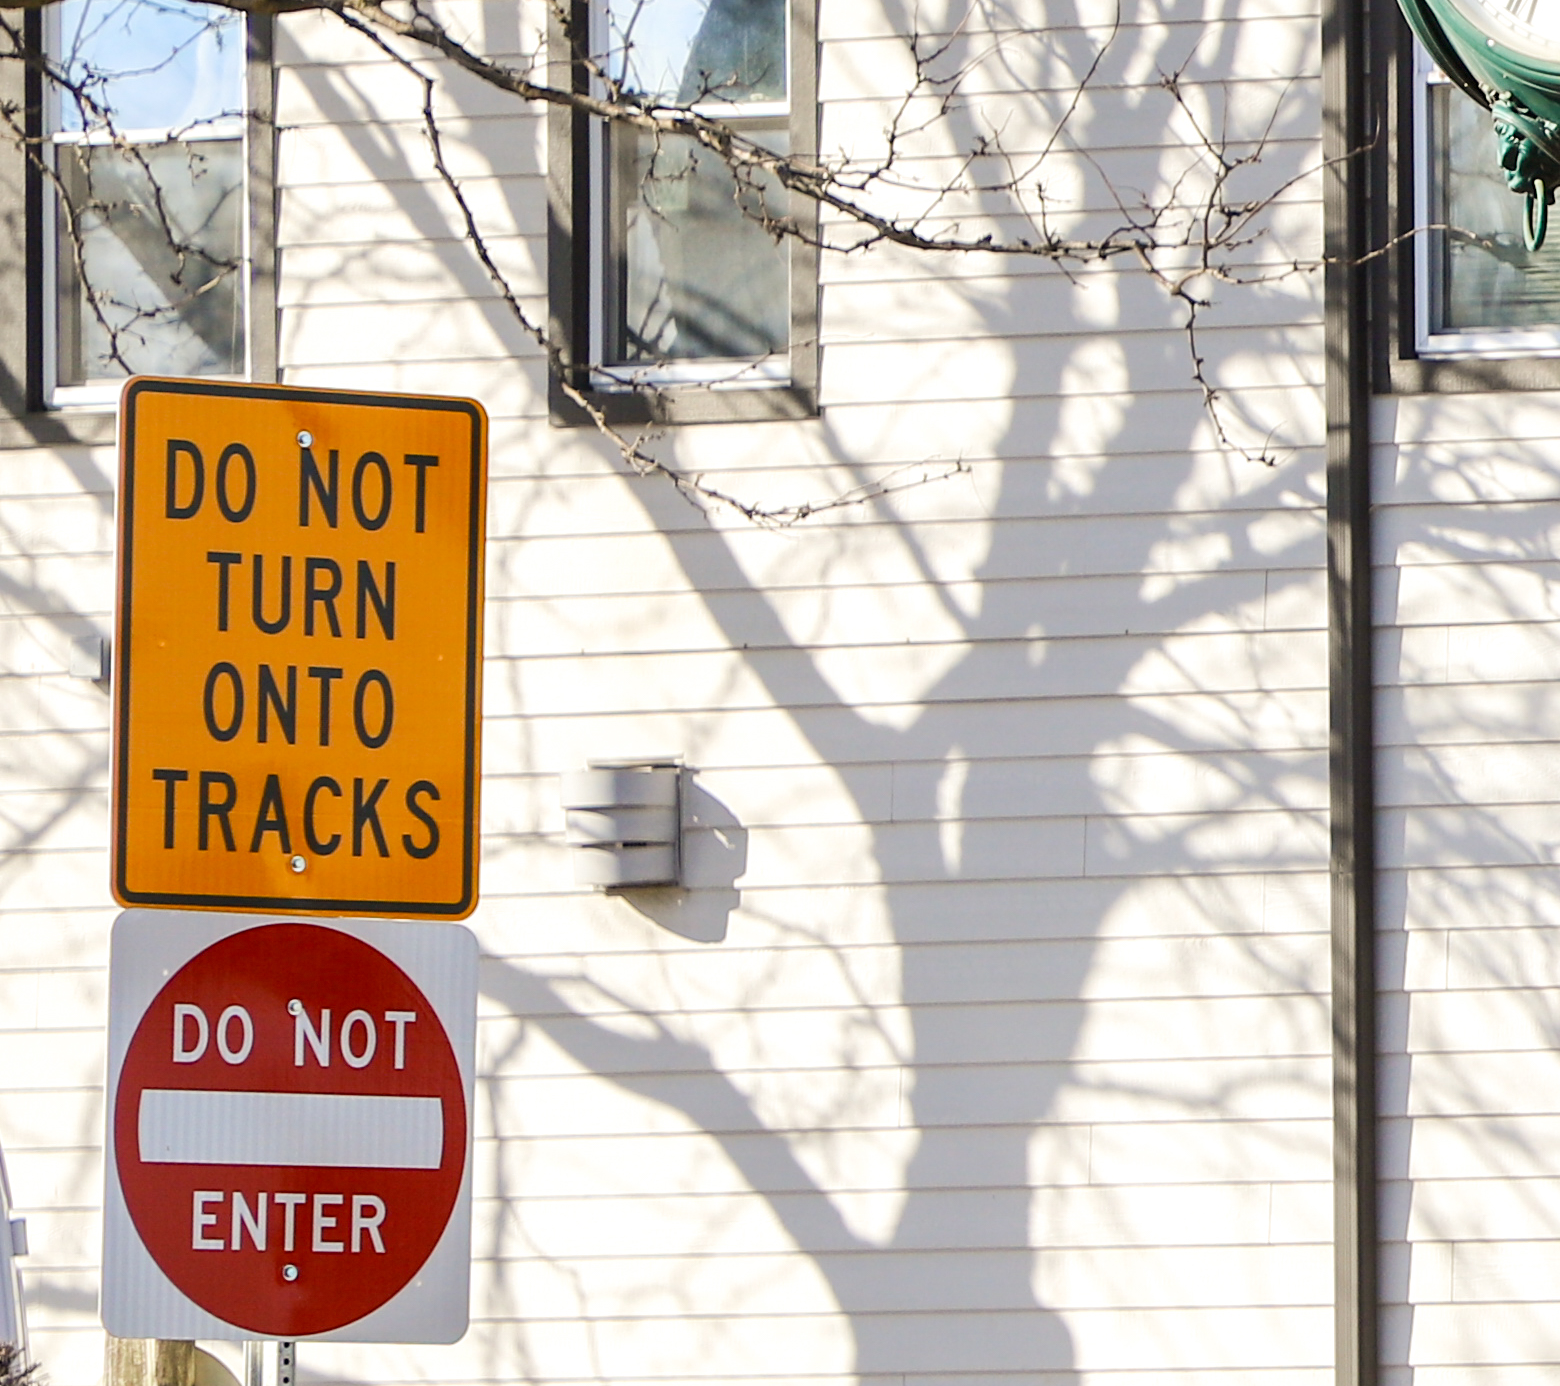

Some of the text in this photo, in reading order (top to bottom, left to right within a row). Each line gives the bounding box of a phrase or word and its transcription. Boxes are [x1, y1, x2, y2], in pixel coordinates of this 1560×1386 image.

[165, 439, 440, 534] DO NOT
[206, 552, 397, 641] TURN
[202, 660, 395, 749] ONTO
[152, 768, 442, 860] TRACKS
[173, 1002, 416, 1070] DO NOT
[190, 1190, 387, 1254] ENTER
